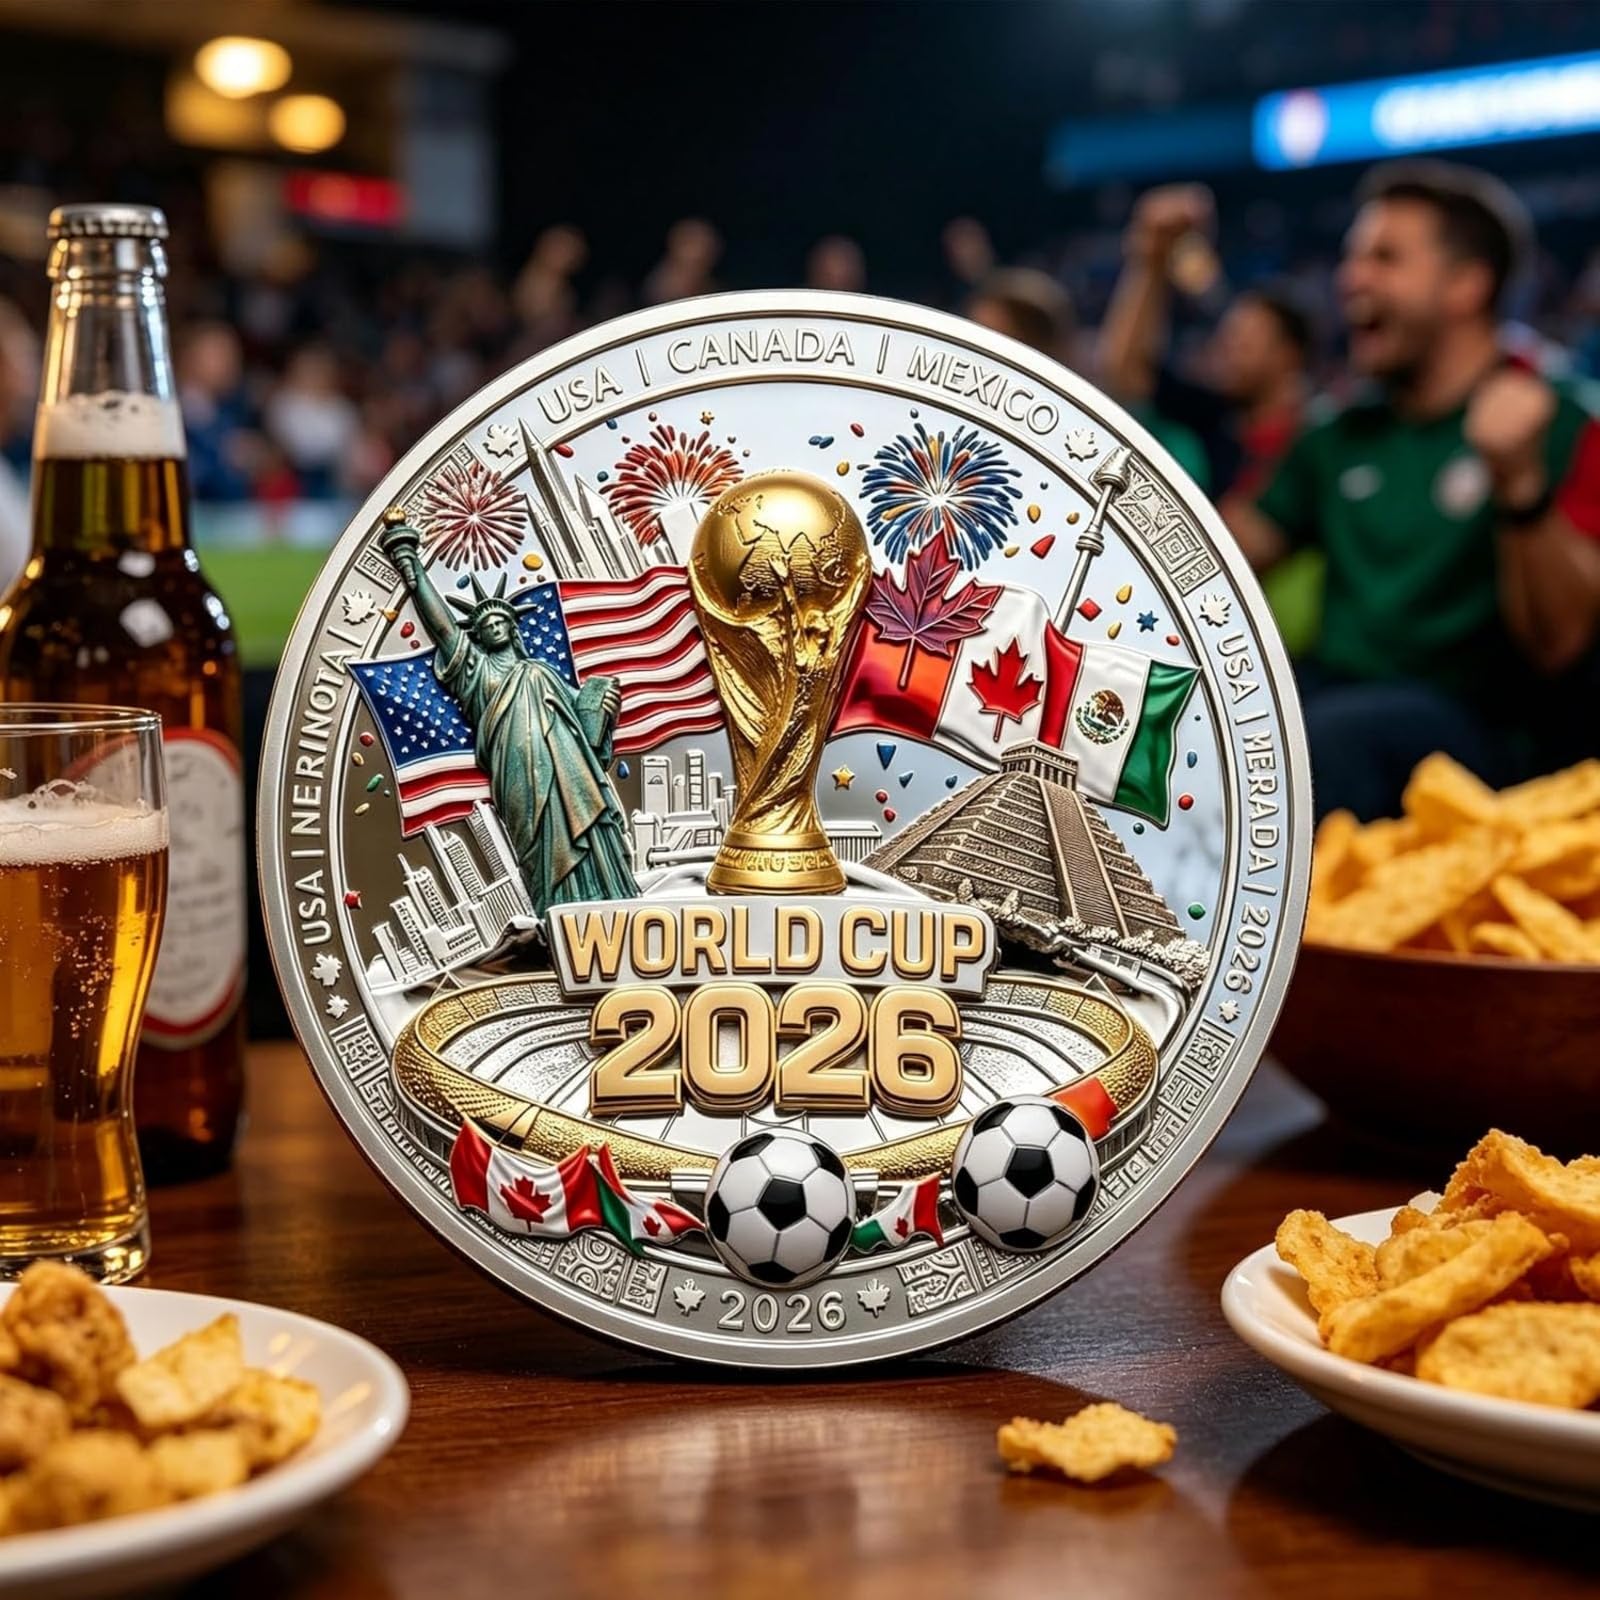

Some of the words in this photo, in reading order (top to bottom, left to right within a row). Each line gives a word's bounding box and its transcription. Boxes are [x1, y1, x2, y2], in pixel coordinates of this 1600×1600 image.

[537, 365, 623, 424] USA
[667, 327, 855, 374] CANADA
[907, 345, 1059, 435] MEXICO
[1217, 633, 1260, 705] USA
[294, 869, 332, 945] USA
[560, 904, 823, 983] WORLD
[839, 906, 986, 983] CUP
[1223, 902, 1271, 994] 2026
[590, 984, 963, 1117] 2026
[717, 1289, 847, 1334] 2026
